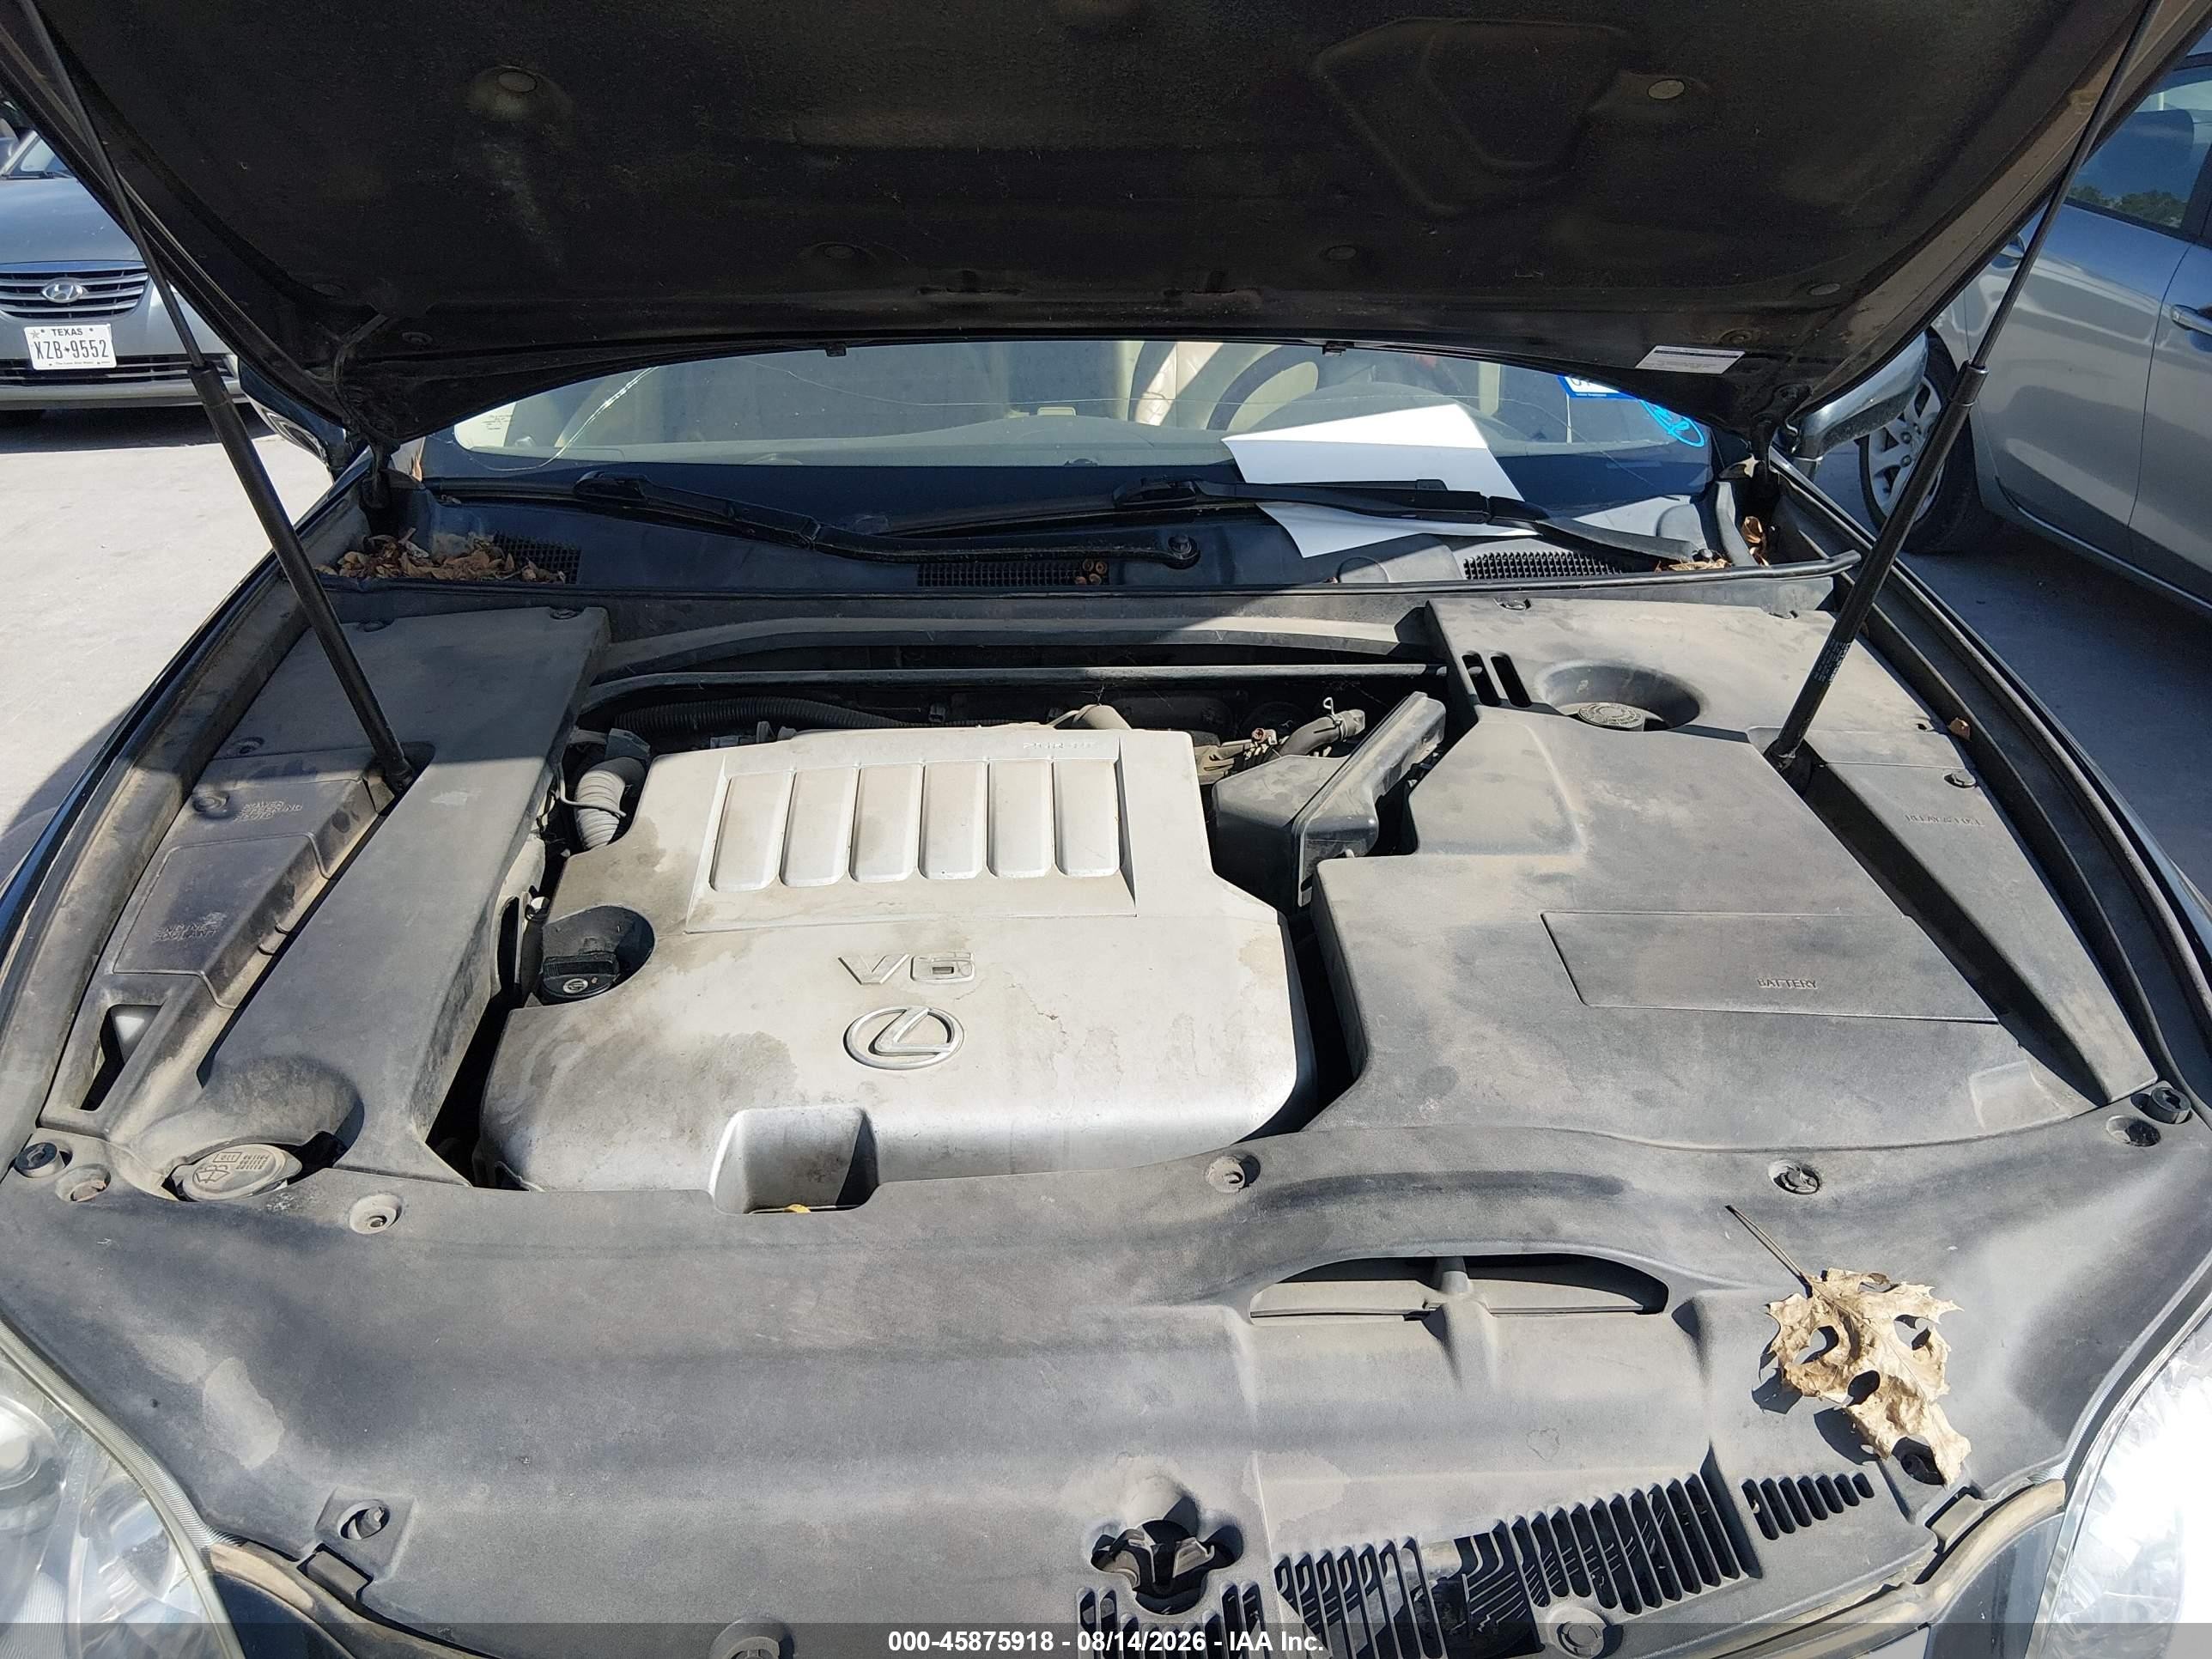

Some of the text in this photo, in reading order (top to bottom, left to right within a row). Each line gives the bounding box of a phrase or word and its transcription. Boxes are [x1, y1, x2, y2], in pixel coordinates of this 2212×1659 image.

[52, 328, 83, 337] TEXAS
[837, 951, 975, 986] V6
[1756, 977, 1819, 990] BATTERY
